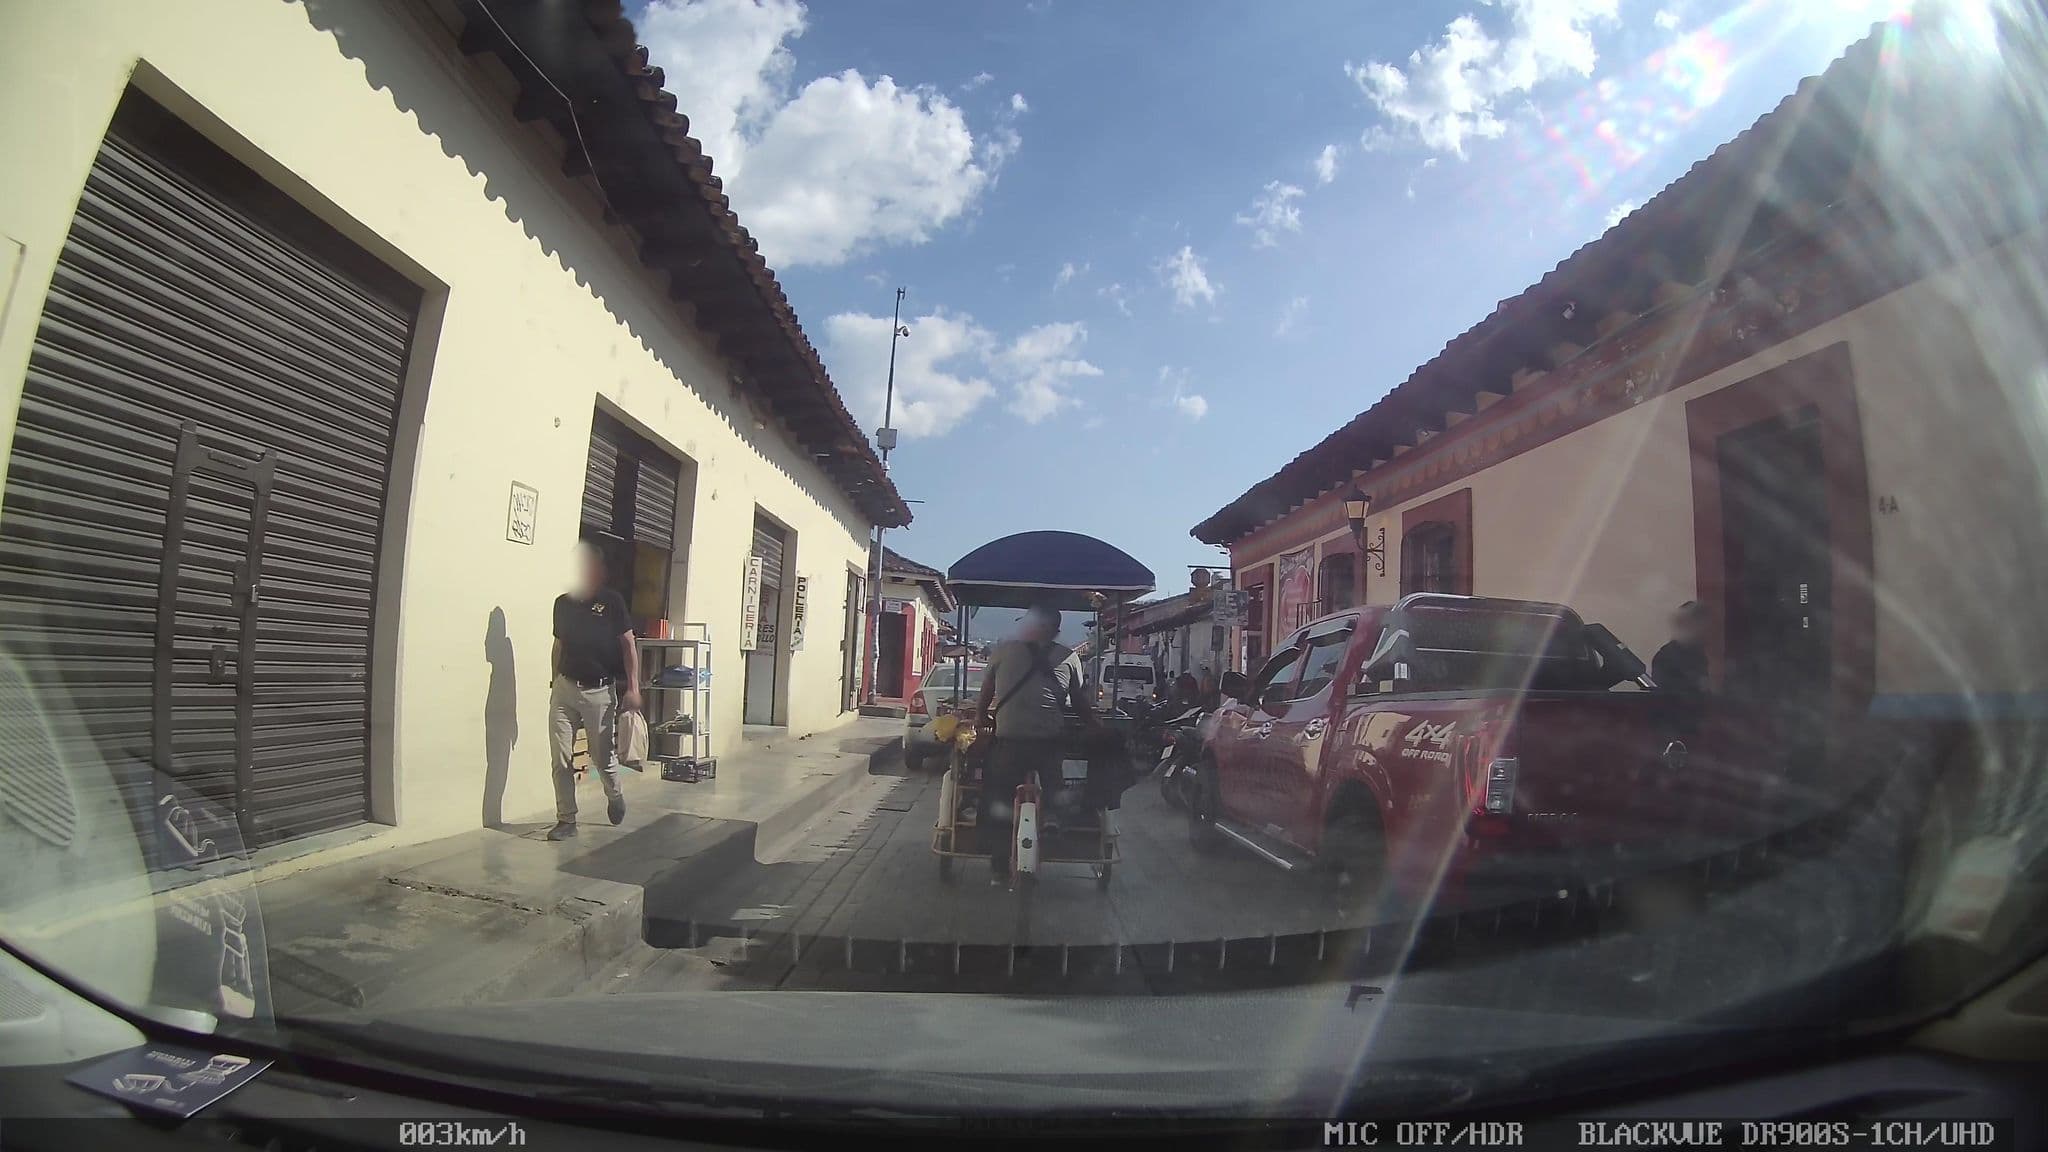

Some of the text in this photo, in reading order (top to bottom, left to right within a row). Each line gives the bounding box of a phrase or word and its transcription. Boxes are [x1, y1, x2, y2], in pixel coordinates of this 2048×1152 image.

[744, 559, 759, 648] CARNICERIA
[794, 577, 806, 635] POLLERIA
[1402, 748, 1421, 759] OFF
